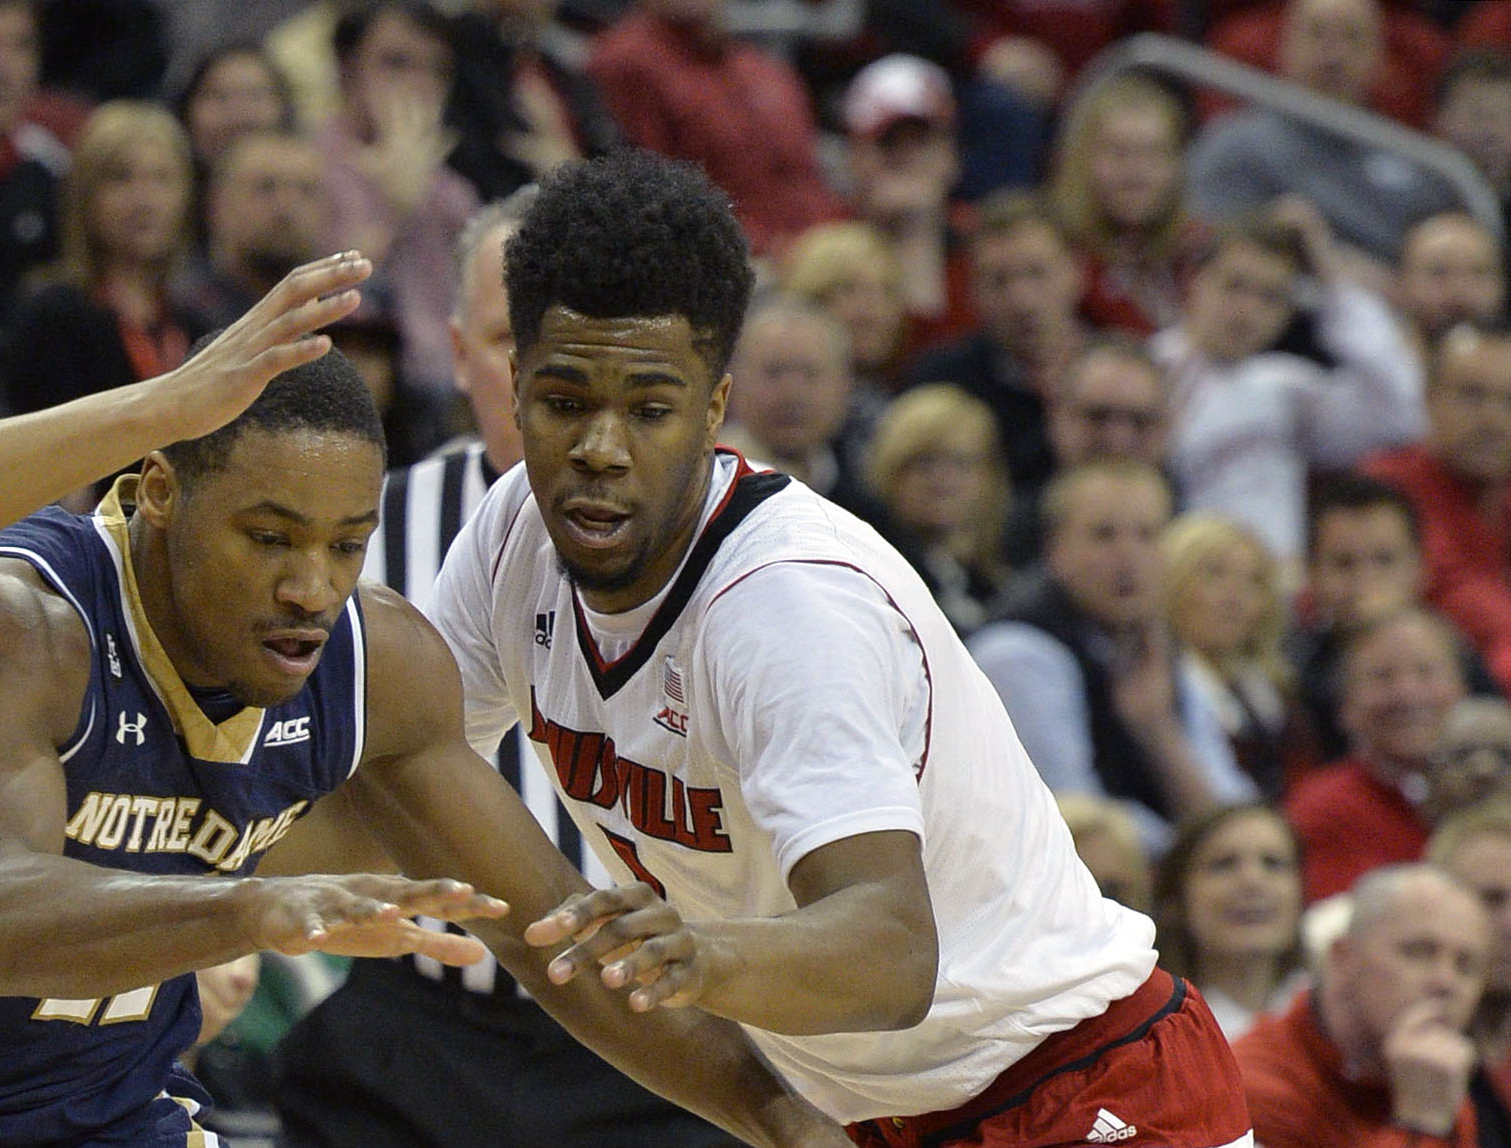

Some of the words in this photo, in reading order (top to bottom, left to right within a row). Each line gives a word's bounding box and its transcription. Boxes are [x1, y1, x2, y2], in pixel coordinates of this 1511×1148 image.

[264, 716, 311, 744] ACC
[655, 706, 689, 733] ACC
[65, 791, 202, 854] NOTRE
[188, 800, 309, 872] DAME
